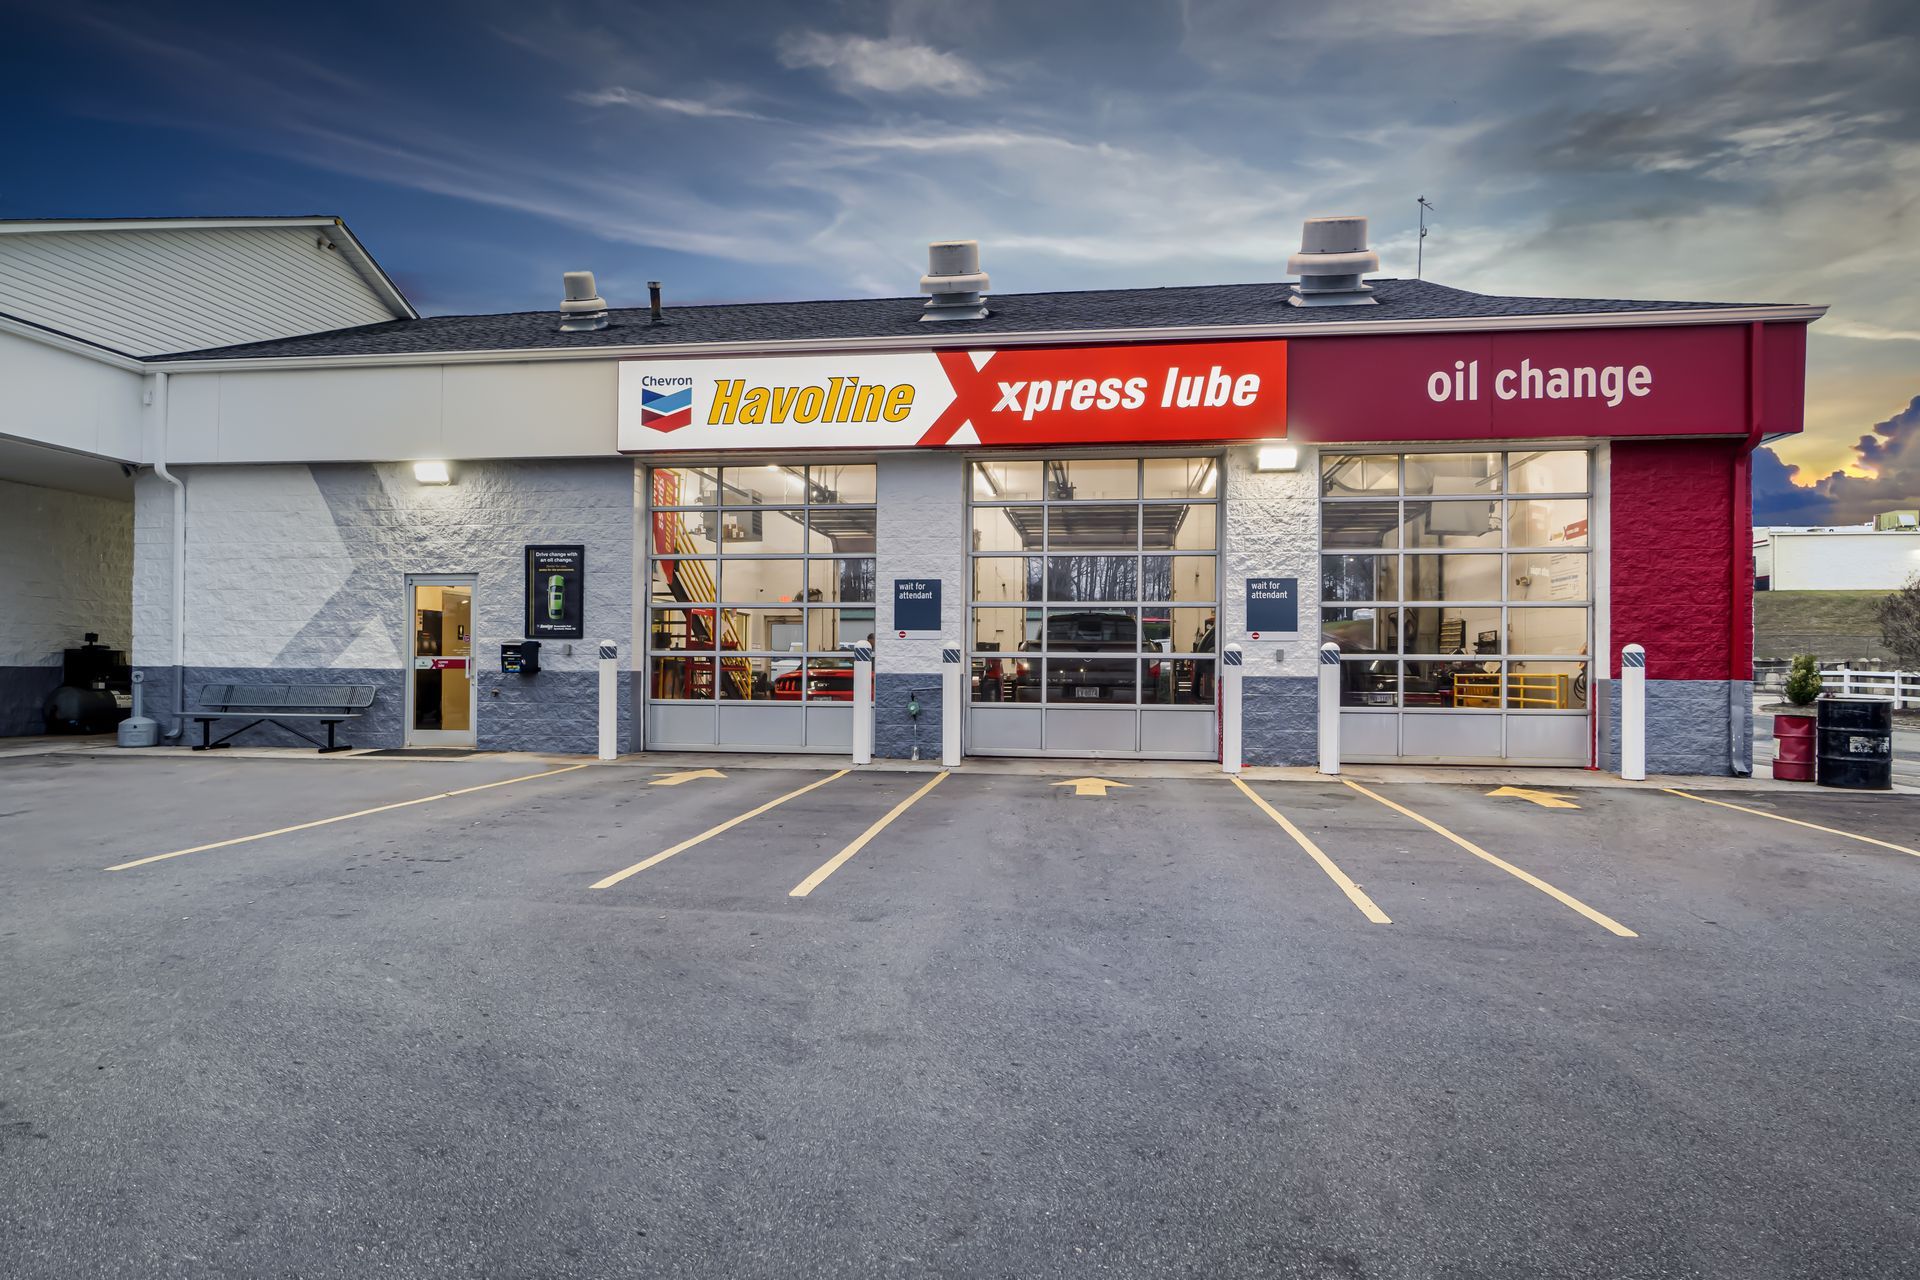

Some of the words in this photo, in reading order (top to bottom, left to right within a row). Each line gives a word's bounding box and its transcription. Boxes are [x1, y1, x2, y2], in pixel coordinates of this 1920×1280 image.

[641, 375, 693, 387] Chevron
[1427, 360, 1478, 402] oil
[1494, 358, 1653, 408] change
[707, 376, 916, 425] Havoline
[991, 377, 1149, 421] xpress
[1160, 366, 1261, 408] lube
[665, 480, 674, 553] Haoline
[898, 582, 914, 591] wait
[915, 581, 926, 590] for
[1251, 580, 1267, 590] wait
[1269, 580, 1281, 590] for
[898, 591, 933, 600] attendant
[1251, 590, 1288, 599] attendant
